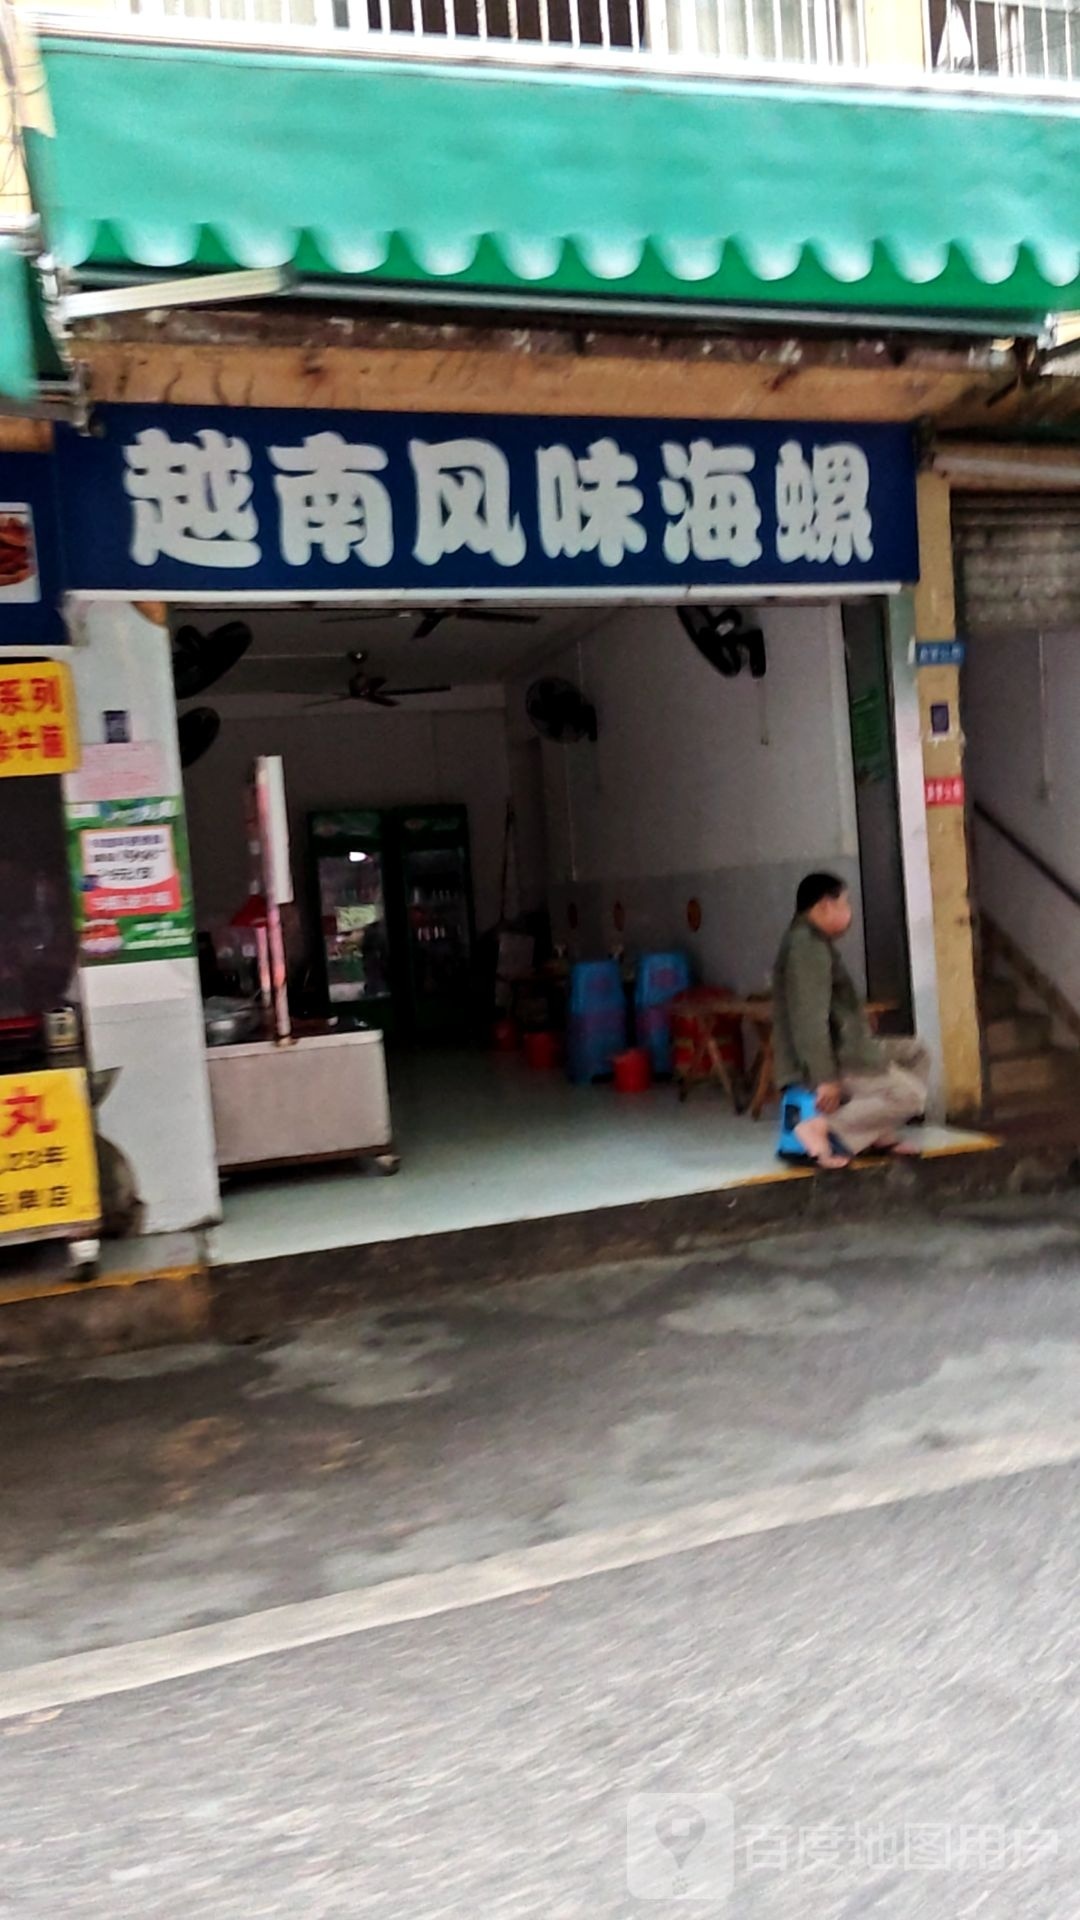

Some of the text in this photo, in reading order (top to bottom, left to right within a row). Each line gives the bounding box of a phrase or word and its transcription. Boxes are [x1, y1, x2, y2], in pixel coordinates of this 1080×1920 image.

[123, 427, 873, 568] 越南风味海螺
